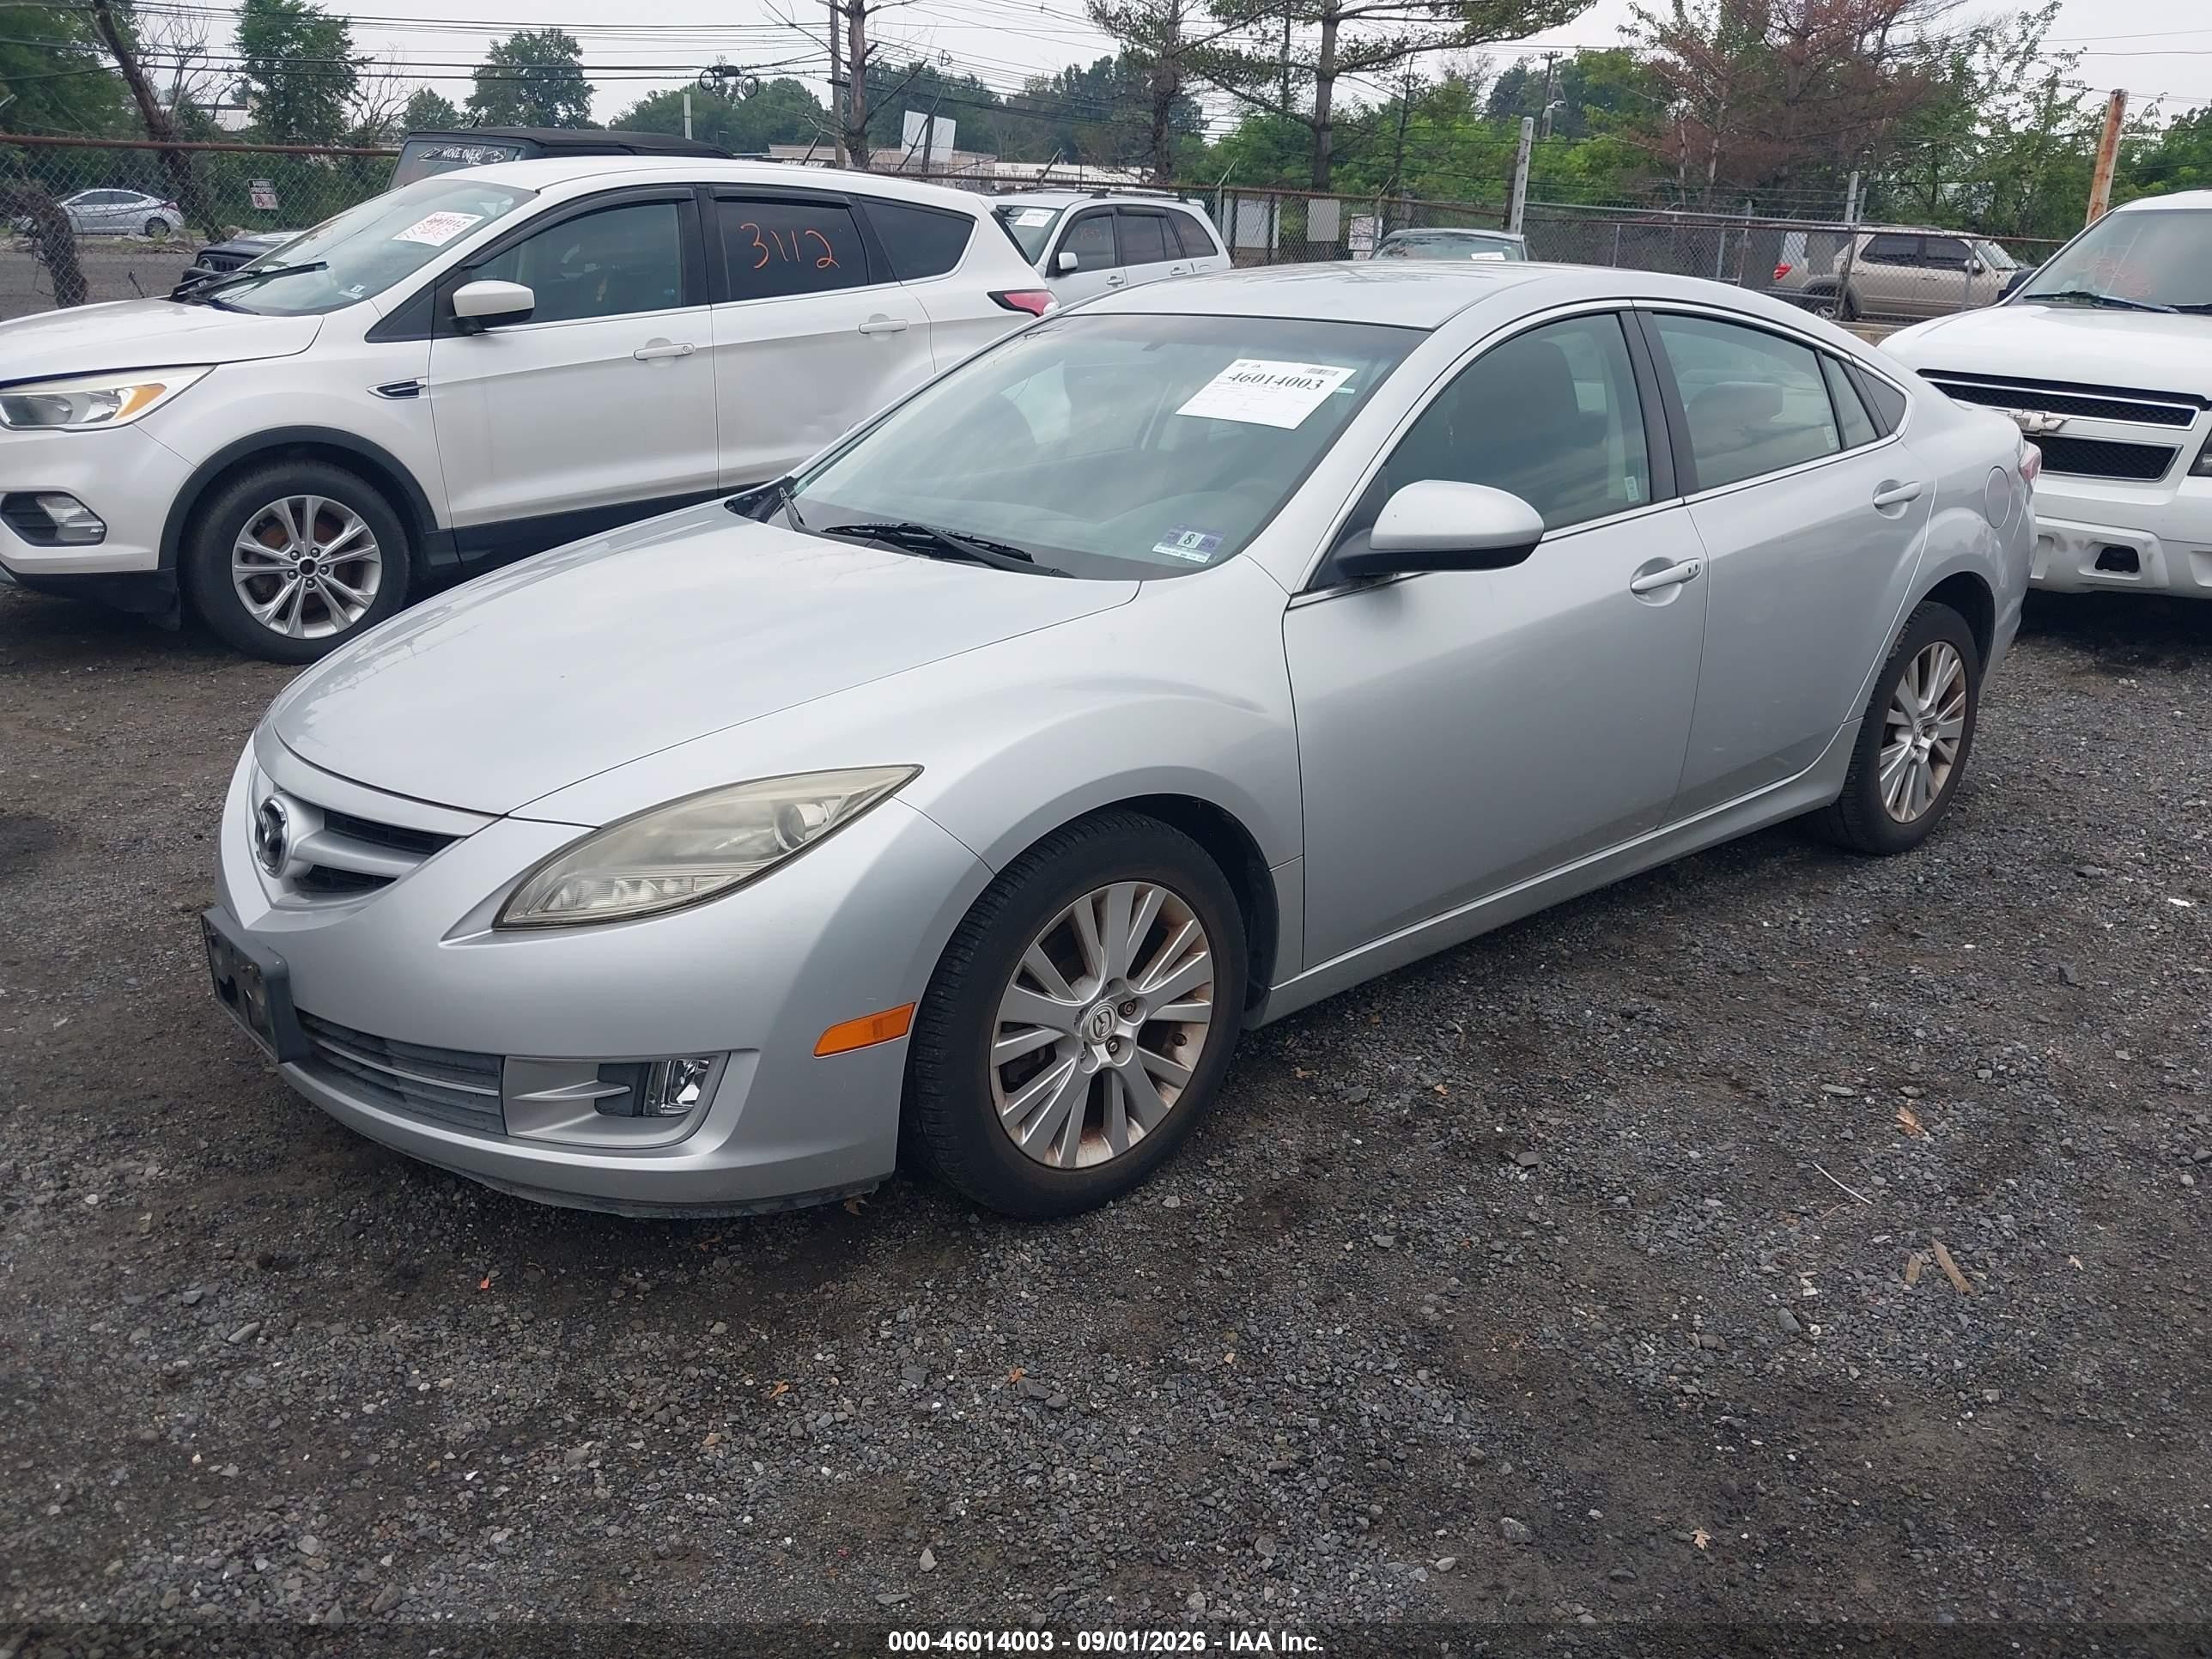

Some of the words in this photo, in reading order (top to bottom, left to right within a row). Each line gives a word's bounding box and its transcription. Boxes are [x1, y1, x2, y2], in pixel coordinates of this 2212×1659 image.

[441, 146, 461, 159] MOVE
[740, 222, 841, 269] 3112
[1228, 371, 1325, 391] 46014003
[1183, 533, 1196, 545] 8
